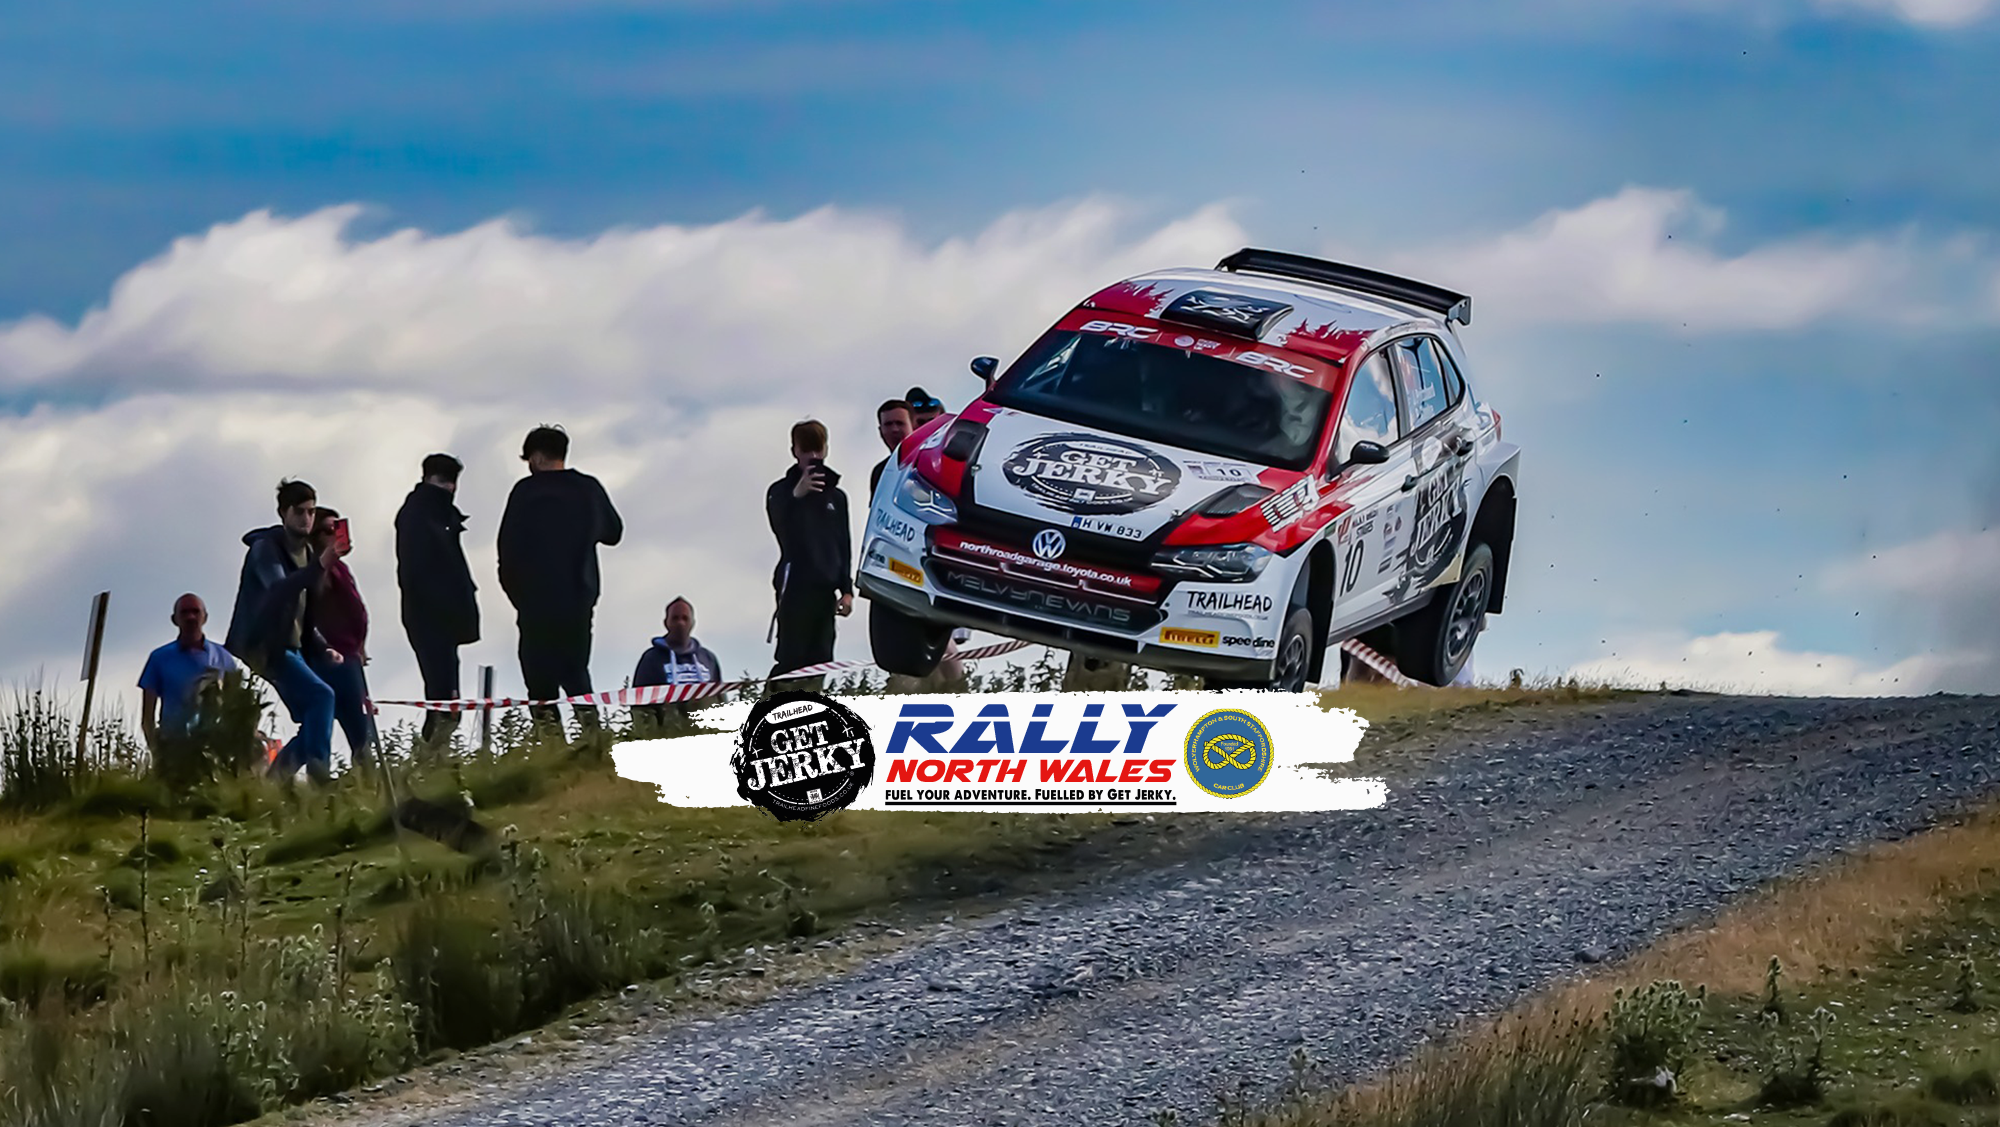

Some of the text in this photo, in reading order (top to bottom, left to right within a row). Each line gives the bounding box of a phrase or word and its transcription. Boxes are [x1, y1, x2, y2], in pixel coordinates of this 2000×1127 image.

[1080, 320, 1158, 339] BRC
[1235, 351, 1314, 378] BRC
[1060, 450, 1137, 472] GET
[1012, 458, 1171, 495] JERKY
[1216, 468, 1241, 477] 10
[1082, 519, 1142, 539] H VW 833
[959, 541, 1133, 587] northroadgarage.toyota.co.uk
[1340, 539, 1364, 597] 10
[1187, 591, 1272, 613] TRAILHEAD
